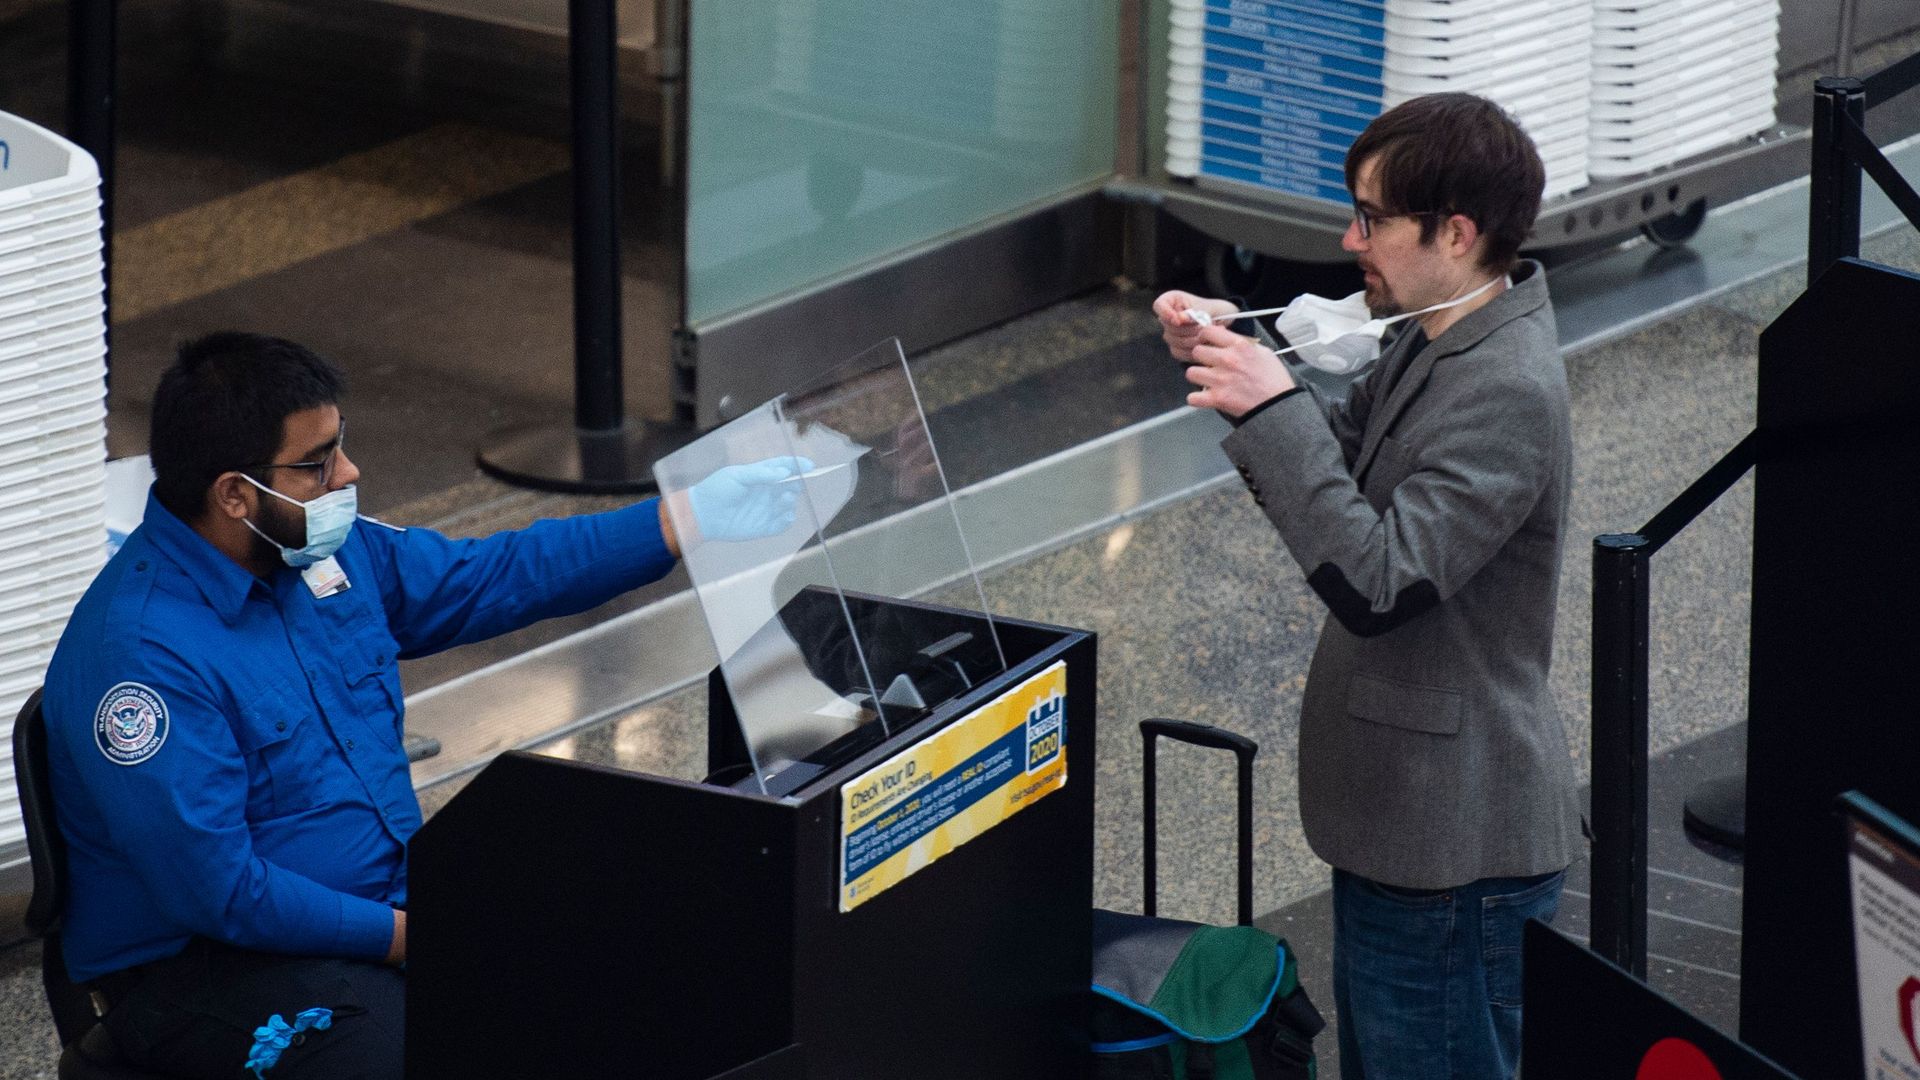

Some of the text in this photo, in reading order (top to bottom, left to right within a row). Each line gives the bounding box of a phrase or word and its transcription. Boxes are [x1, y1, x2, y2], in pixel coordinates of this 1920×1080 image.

[139, 691, 163, 719] SECURITY
[107, 736, 160, 758] ADMINISTRATION
[1030, 732, 1058, 764] 2020
[851, 761, 916, 809] Check Your ID
